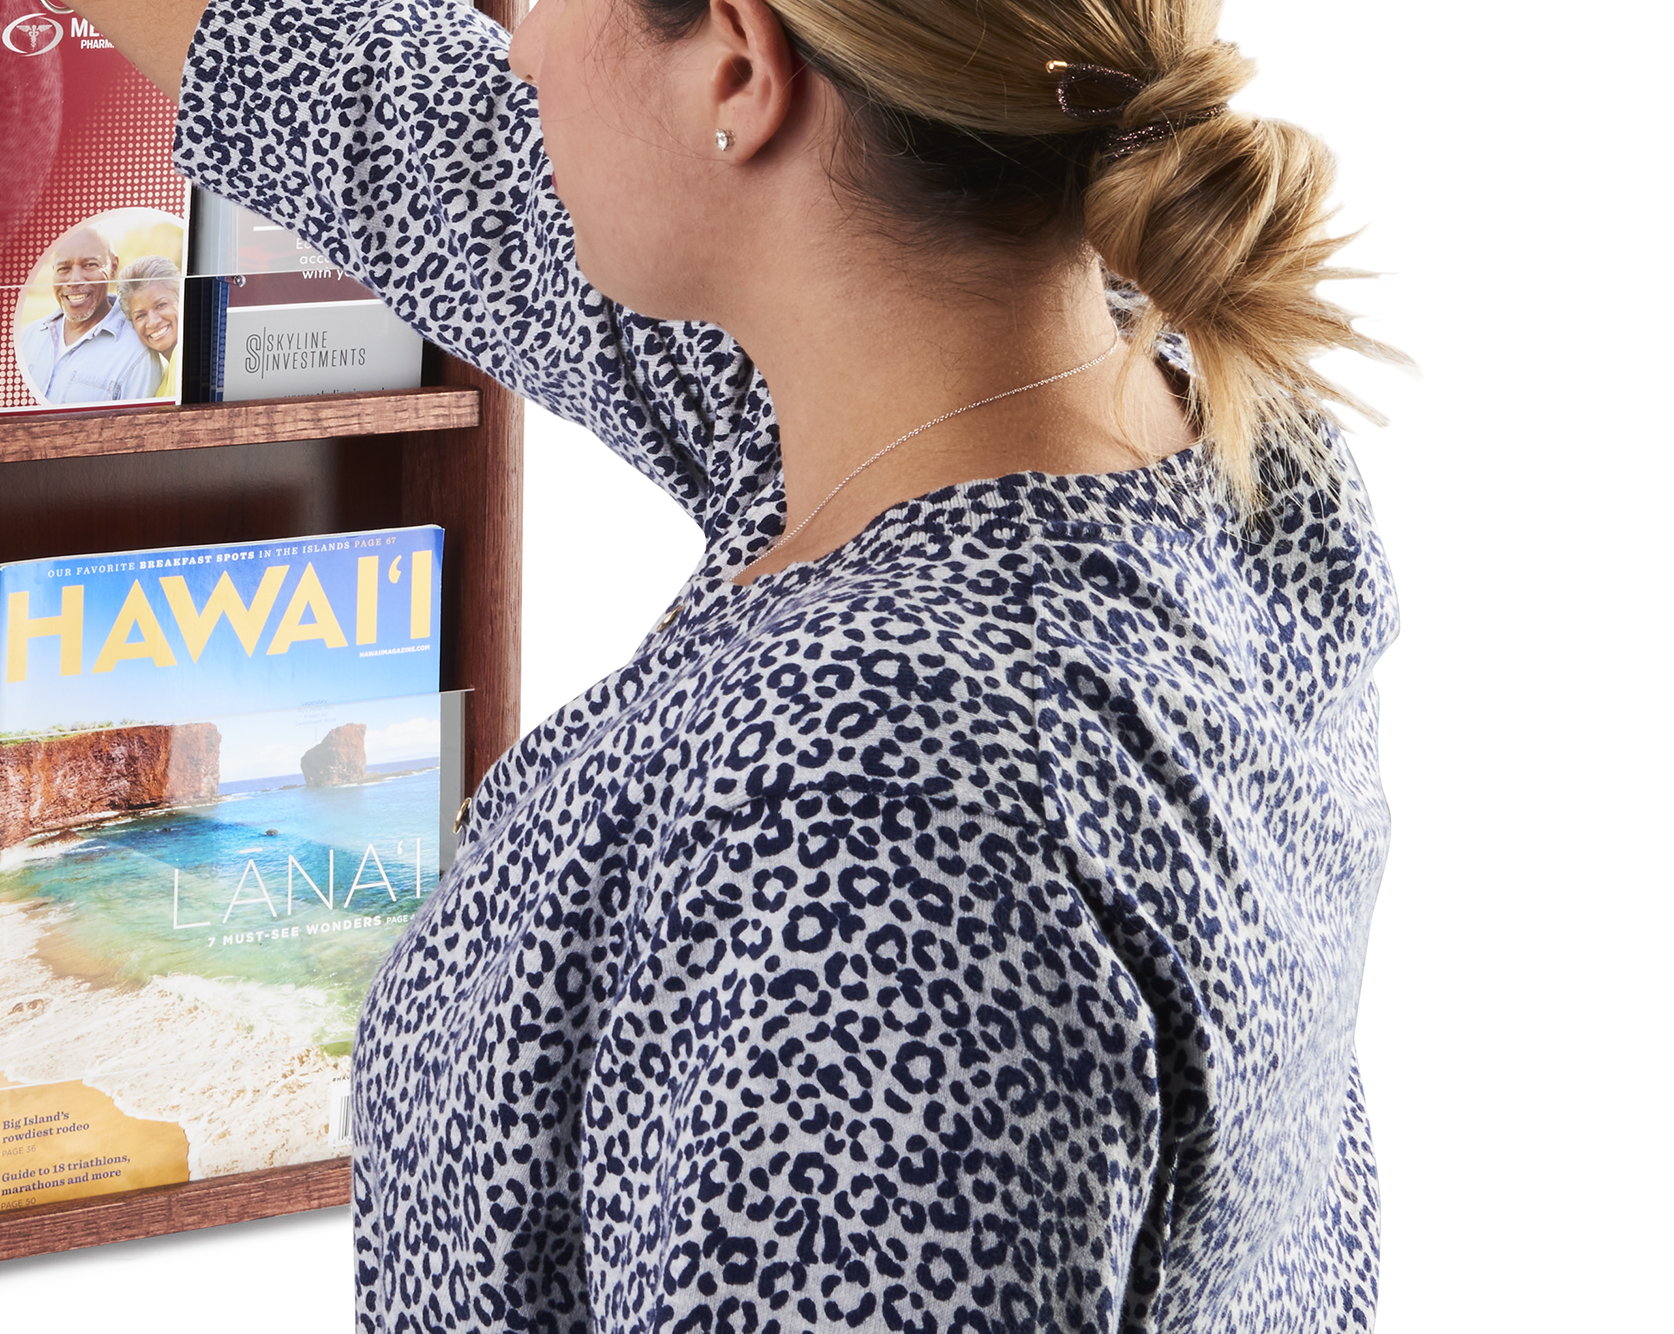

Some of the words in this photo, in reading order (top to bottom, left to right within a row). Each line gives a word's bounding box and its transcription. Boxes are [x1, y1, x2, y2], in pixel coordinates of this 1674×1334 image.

[267, 331, 328, 351] SKYLINE
[266, 348, 366, 371] INVESTMENTS
[48, 568, 72, 578] OUR
[76, 562, 135, 576] FAVORITE
[139, 556, 213, 569] BREAKFAST
[216, 551, 255, 562] SPOTS
[259, 550, 272, 559] IN
[276, 547, 298, 557] THE
[302, 541, 350, 554] ISLANDS
[354, 538, 382, 549] PAGE
[359, 644, 430, 658] HAWAIIMAGAZINE.COM
[208, 937, 215, 947] 7
[223, 927, 299, 946] MUST-SEE
[307, 916, 382, 935] WONDERS
[3, 1119, 21, 1130] Big
[24, 1111, 69, 1126] Island's
[2, 1128, 54, 1143] rowdiest
[56, 1122, 90, 1134] rodeo
